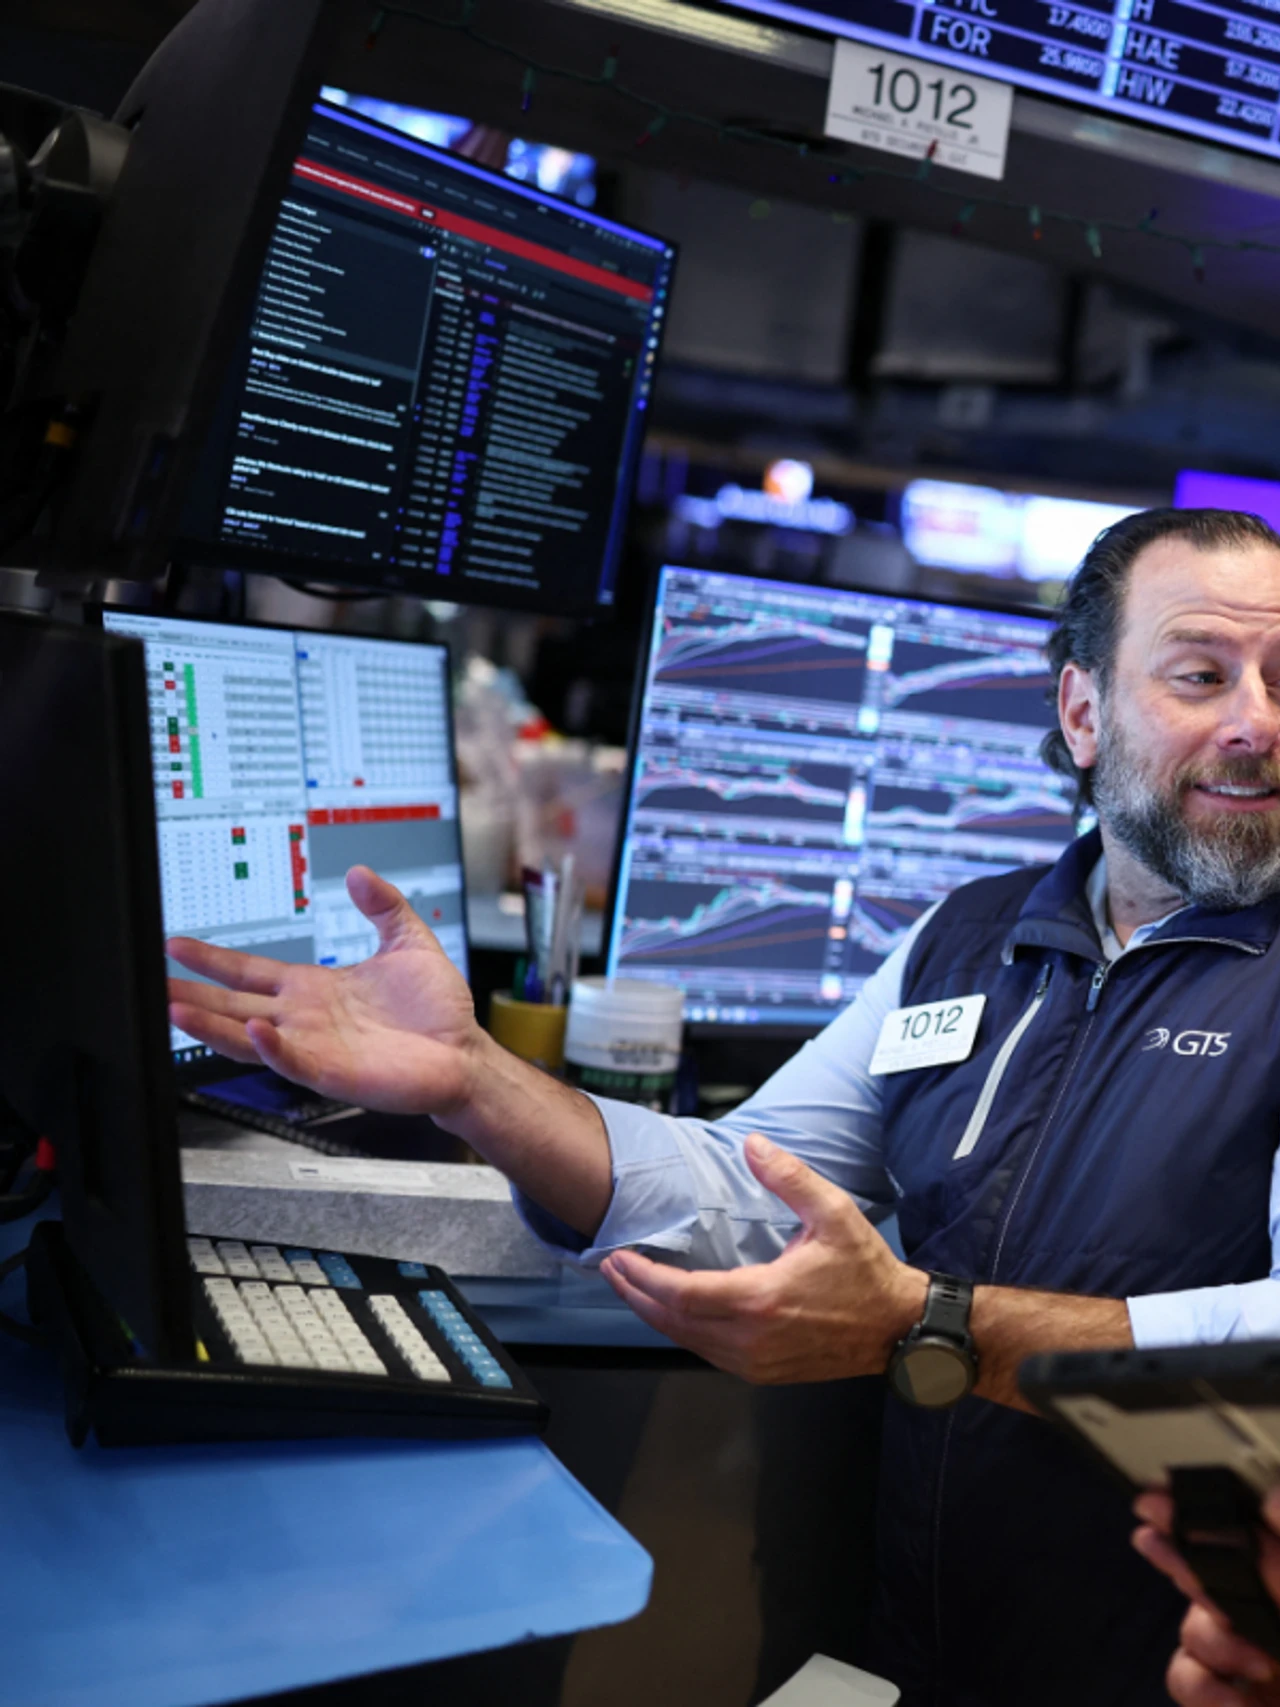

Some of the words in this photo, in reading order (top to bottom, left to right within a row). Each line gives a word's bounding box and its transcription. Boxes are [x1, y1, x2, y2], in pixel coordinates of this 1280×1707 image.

[931, 15, 991, 56] FOR
[1125, 29, 1182, 71] HAE
[867, 63, 978, 130] 1012
[1117, 67, 1176, 107] HIW
[901, 1004, 964, 1041] 1012
[1172, 1030, 1232, 1057] GTS
